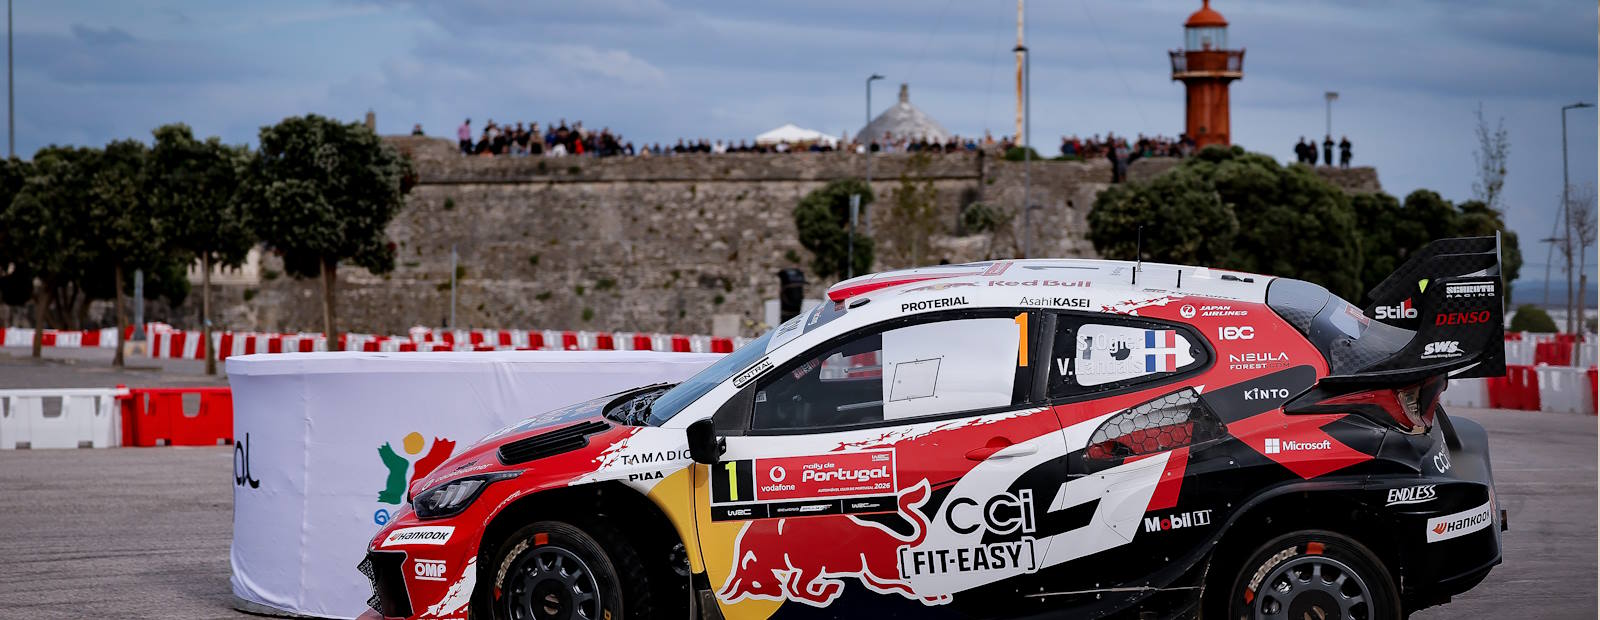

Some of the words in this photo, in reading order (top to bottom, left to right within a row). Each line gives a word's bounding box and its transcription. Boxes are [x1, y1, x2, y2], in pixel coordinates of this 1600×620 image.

[988, 279, 1038, 287] Red
[1043, 280, 1091, 288] Bull
[901, 296, 969, 312] PROTERIAL
[1020, 296, 1090, 308] AsahiKASEI
[1375, 299, 1418, 319] Stilo
[1435, 311, 1491, 327] DENSO
[1014, 312, 1028, 367] 1
[1424, 341, 1464, 355] SWS
[733, 360, 773, 387] CENTRAL
[1282, 438, 1331, 451] Microsoft
[802, 465, 890, 483] Portugal
[803, 463, 822, 471] rally
[629, 470, 664, 482] PIAA
[724, 461, 738, 501] 1
[761, 483, 796, 492] vodafone
[874, 482, 891, 490] 2026
[1386, 484, 1437, 503] ENDLESS
[727, 508, 752, 516] WRC
[1144, 512, 1191, 533] Mobil
[414, 563, 447, 578] OMP
